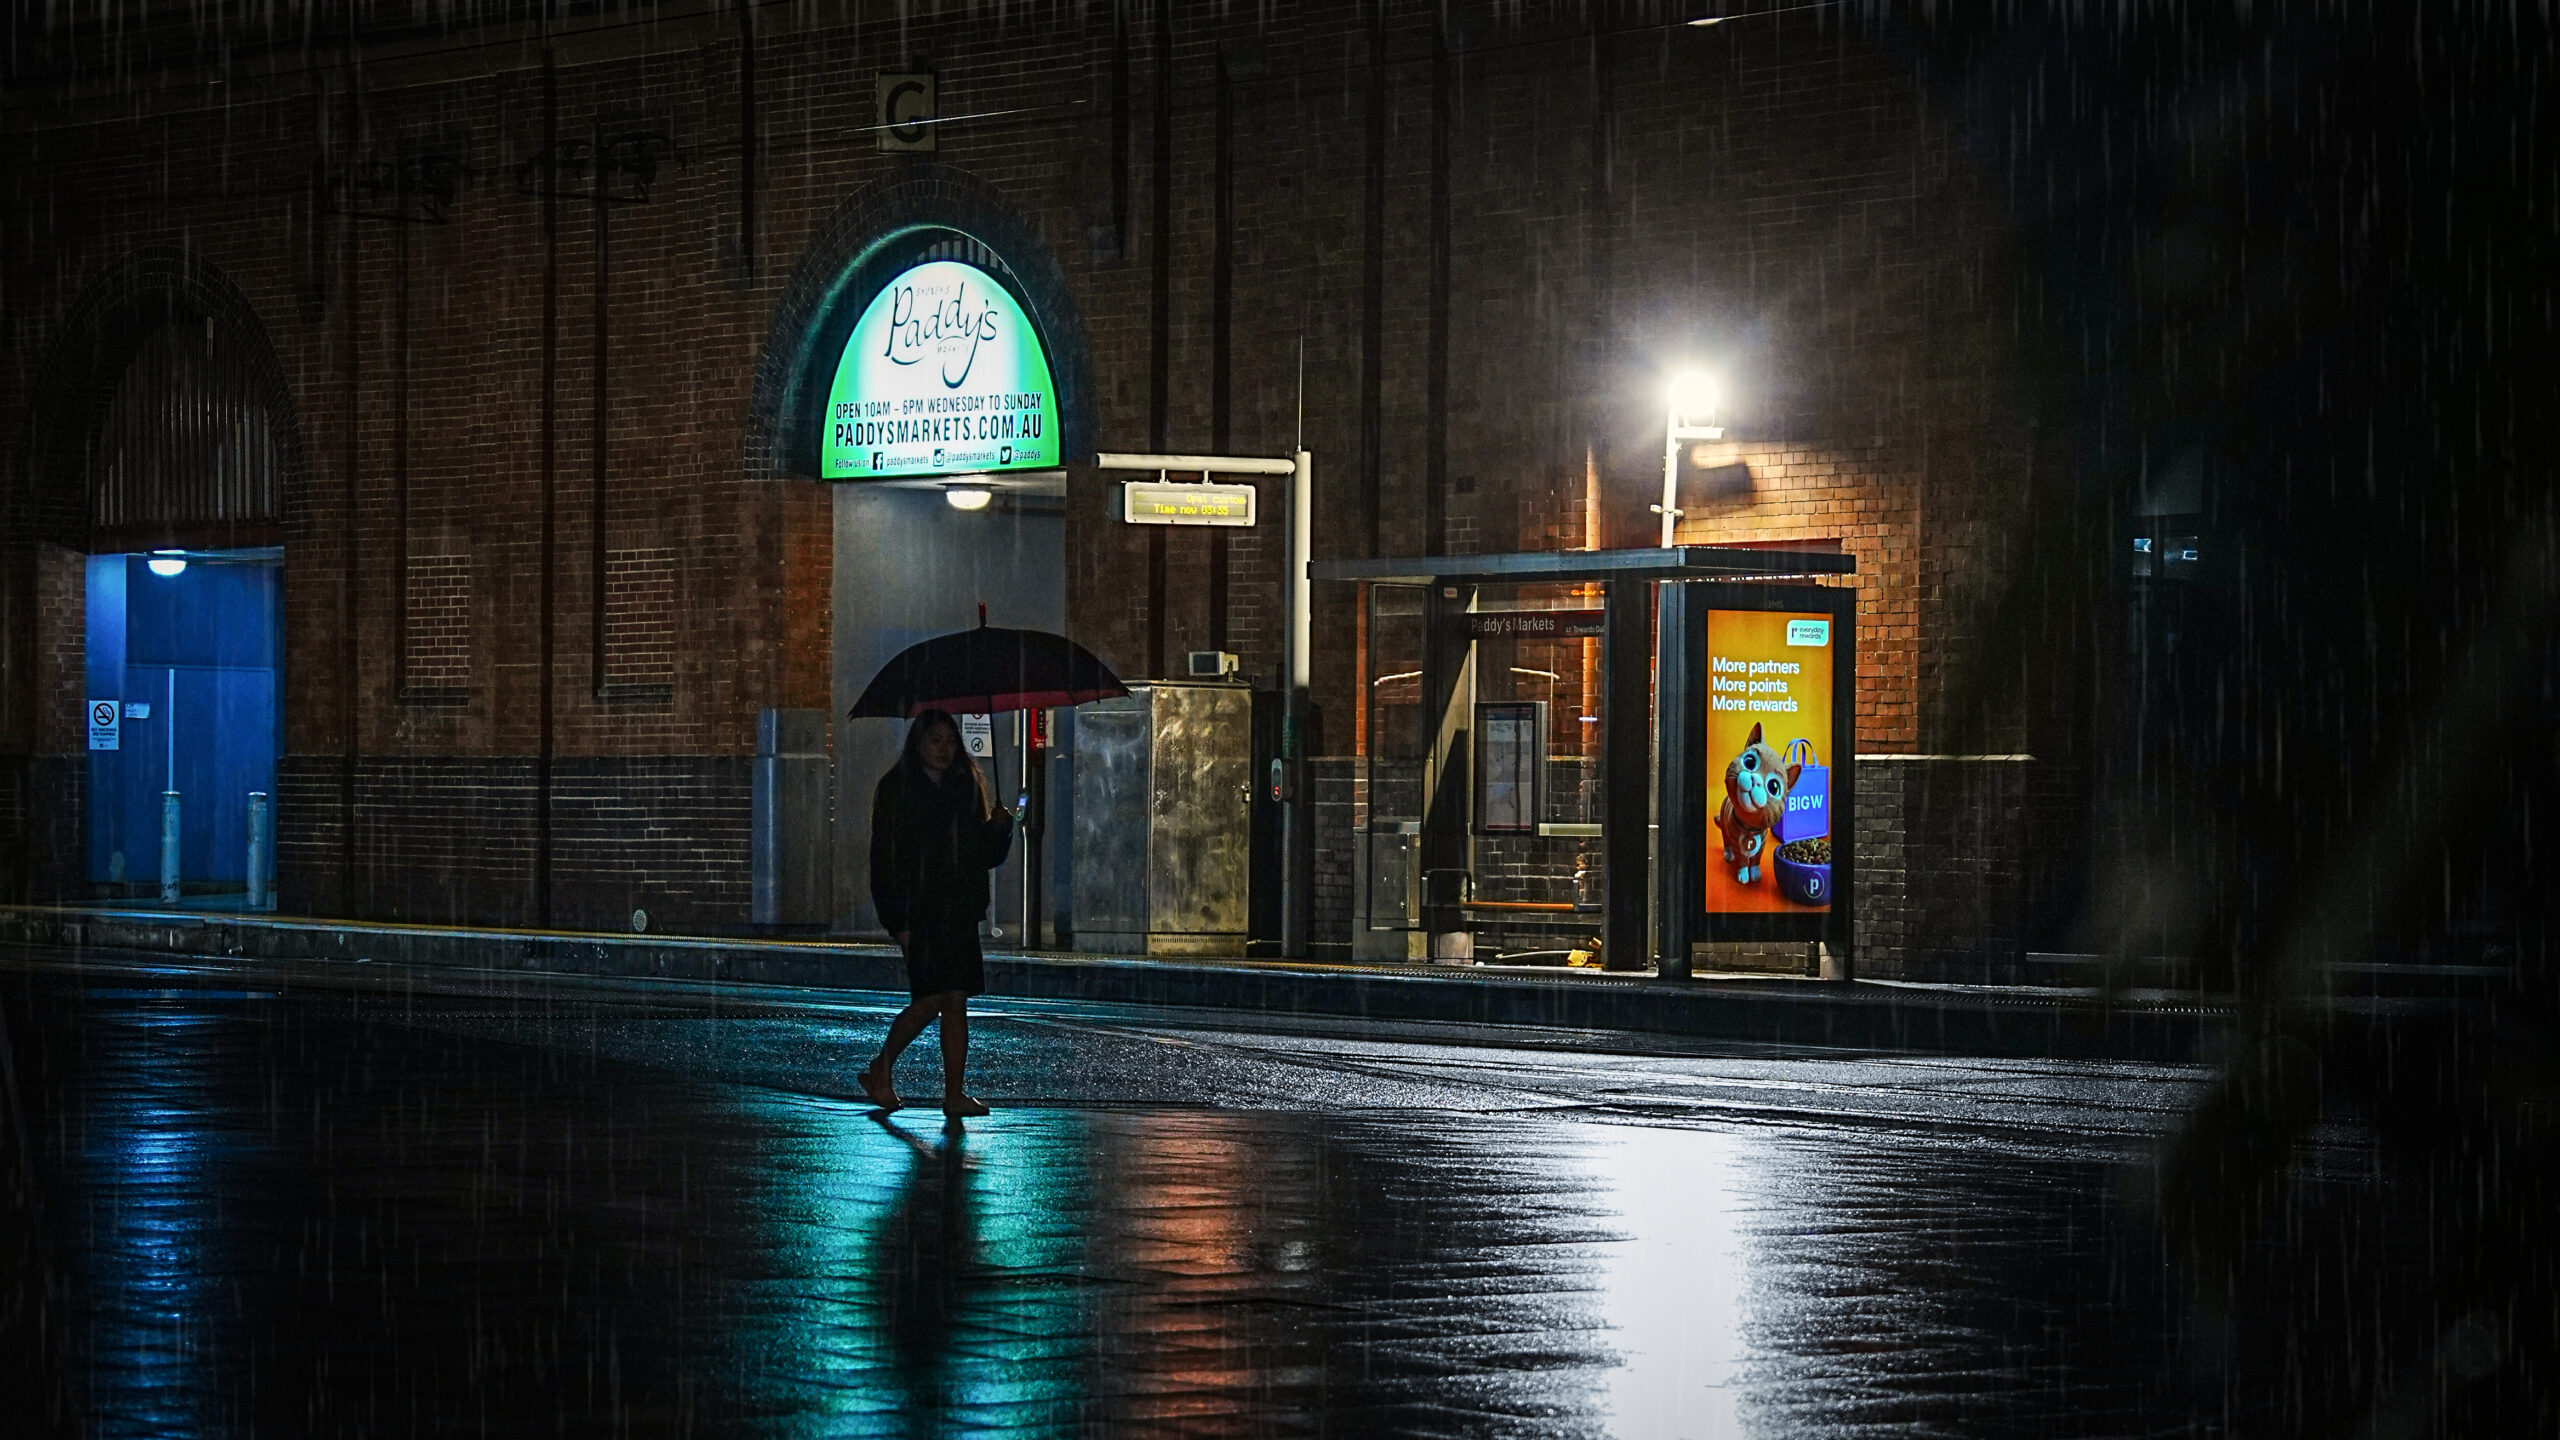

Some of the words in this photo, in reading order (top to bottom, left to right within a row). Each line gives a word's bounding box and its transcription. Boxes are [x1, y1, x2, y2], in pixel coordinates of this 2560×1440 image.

[885, 81, 927, 143] G
[884, 281, 998, 389] Paddy's
[836, 402, 861, 419] OPEN
[864, 401, 891, 417] 10AM
[903, 399, 924, 415] 6PM
[928, 396, 985, 413] WEDNESDAY
[989, 395, 1001, 410] TO
[1004, 393, 1042, 410] SUNDAY
[835, 413, 1042, 447] PADDYSMARKETS.COM.AU
[835, 458, 853, 469] Follow
[854, 460, 861, 468] us
[1013, 449, 1041, 462] @paddys
[1154, 504, 1176, 514] Time
[1180, 506, 1197, 515] now
[1471, 617, 1511, 634] Paddy's
[1513, 616, 1555, 631] Markets
[1800, 627, 1824, 635] everyday
[1712, 657, 1746, 672] More
[1749, 660, 1800, 677] partners
[1712, 676, 1746, 691] More
[1749, 678, 1788, 696] points
[1712, 695, 1746, 710] More
[1749, 696, 1798, 712] rewards
